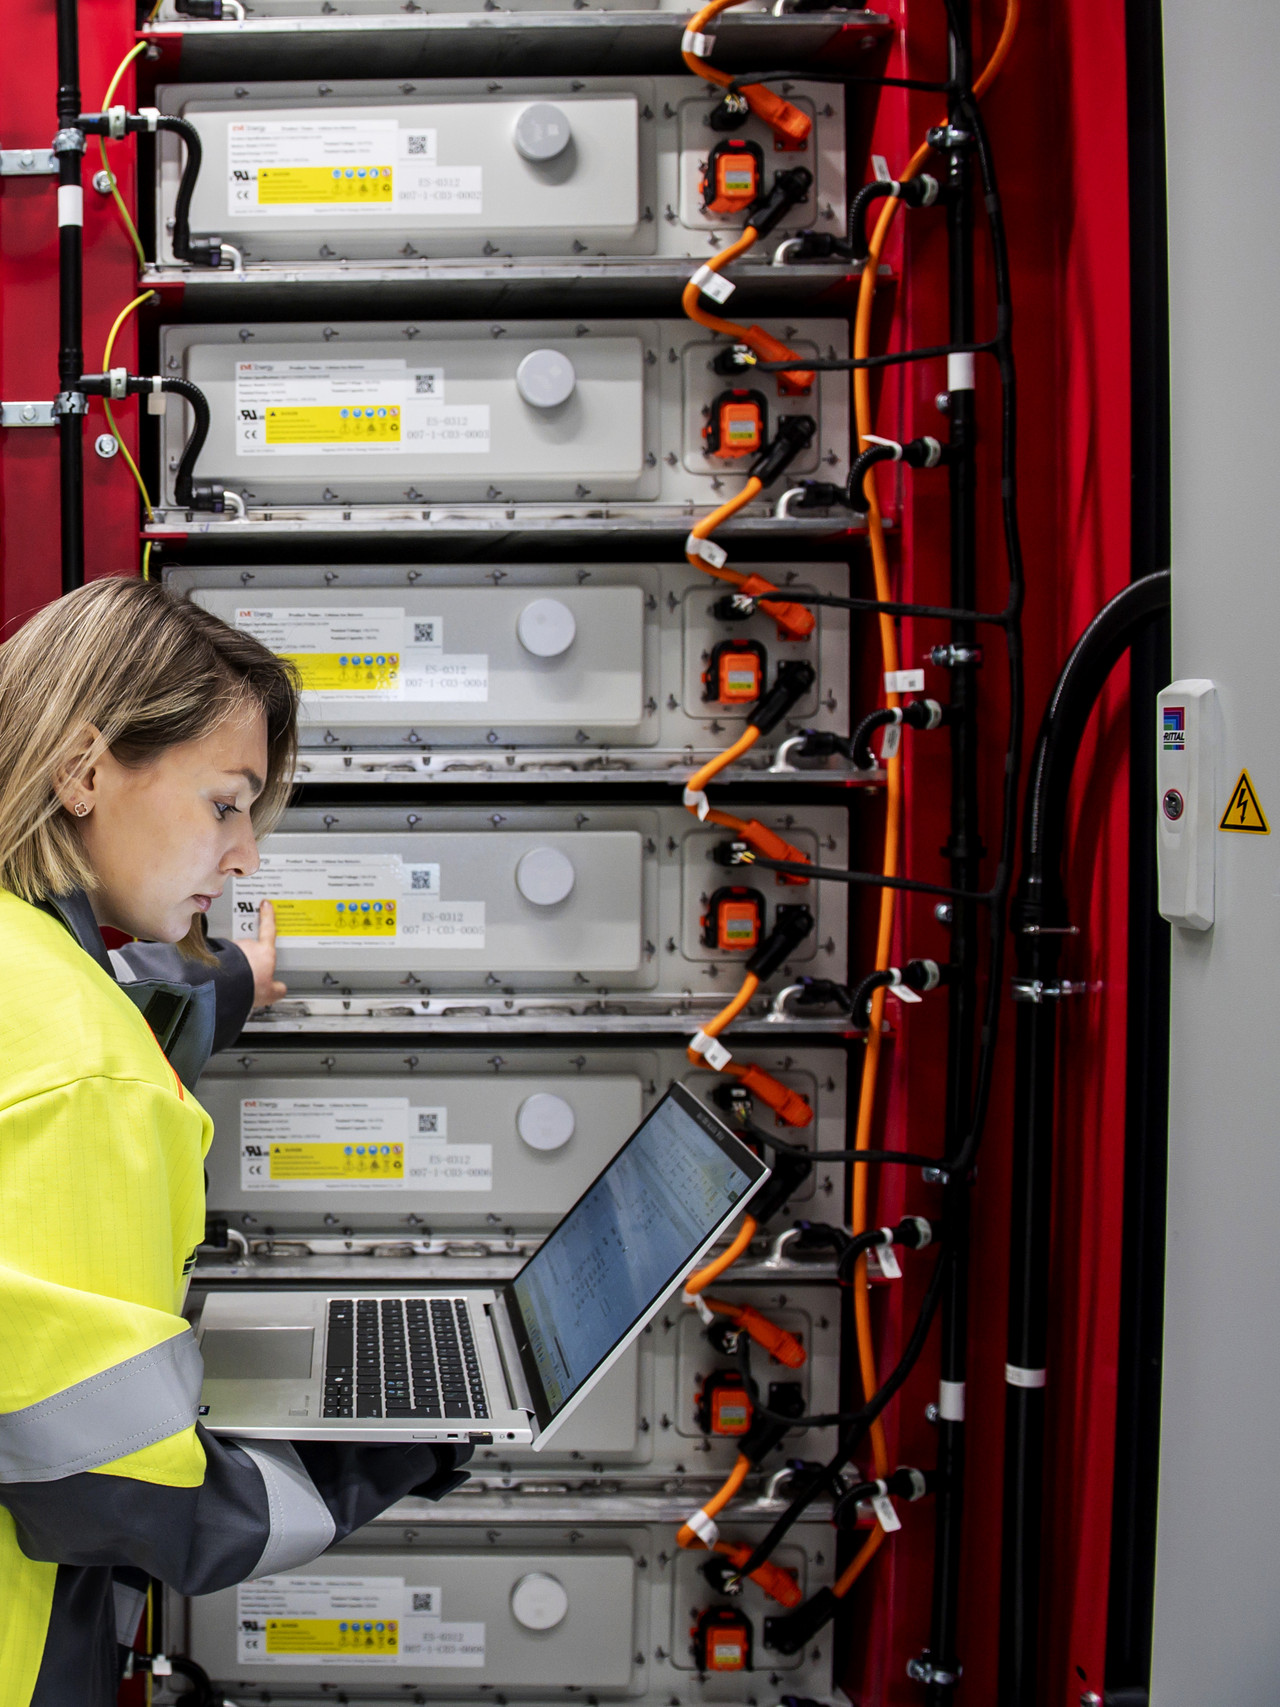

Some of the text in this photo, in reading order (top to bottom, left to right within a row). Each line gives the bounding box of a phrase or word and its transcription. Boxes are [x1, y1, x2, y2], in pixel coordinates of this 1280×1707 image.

[427, 417, 468, 426] ES-0312
[425, 666, 466, 675] ES-0312
[1163, 732, 1185, 740] RITTAL
[422, 912, 463, 922] ES-0312
[429, 1155, 470, 1165] ES-0312
